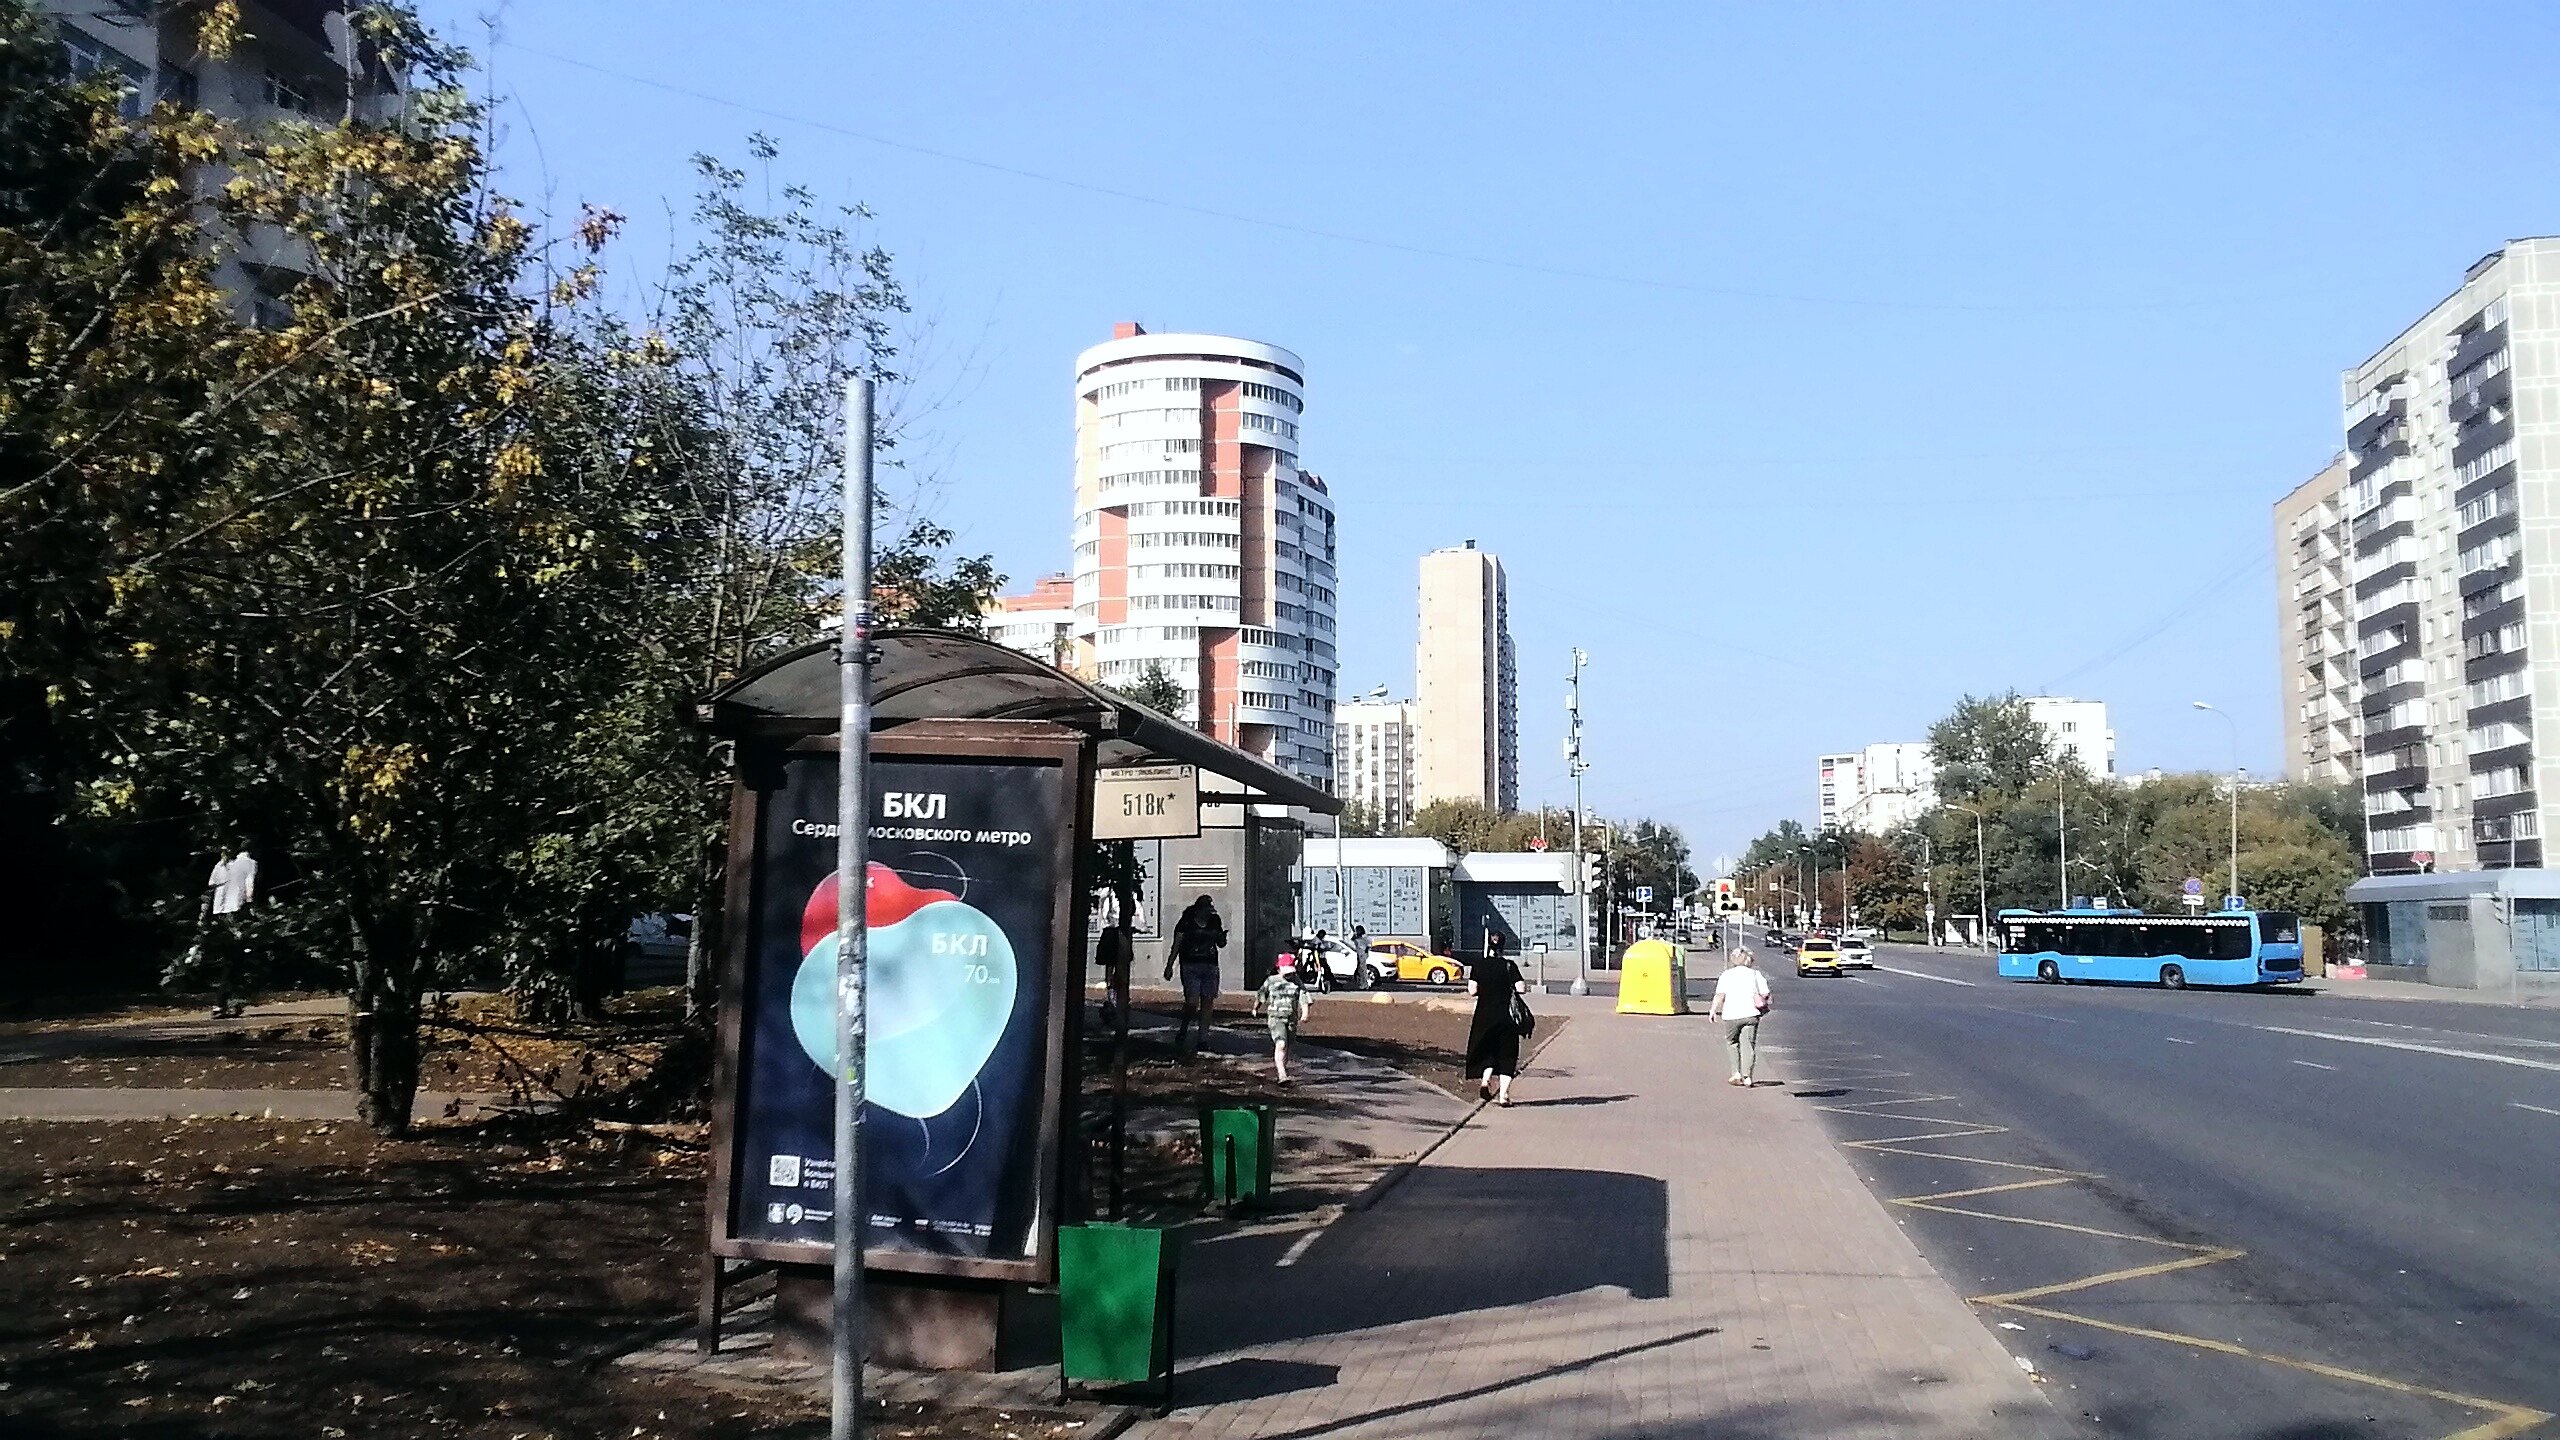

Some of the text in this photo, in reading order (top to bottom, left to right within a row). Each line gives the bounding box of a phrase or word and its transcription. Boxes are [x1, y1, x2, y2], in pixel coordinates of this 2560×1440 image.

[883, 791, 947, 820] БКЛ
[792, 818, 841, 839] Серд
[975, 830, 1032, 848] метро
[931, 932, 988, 957] БКЛ
